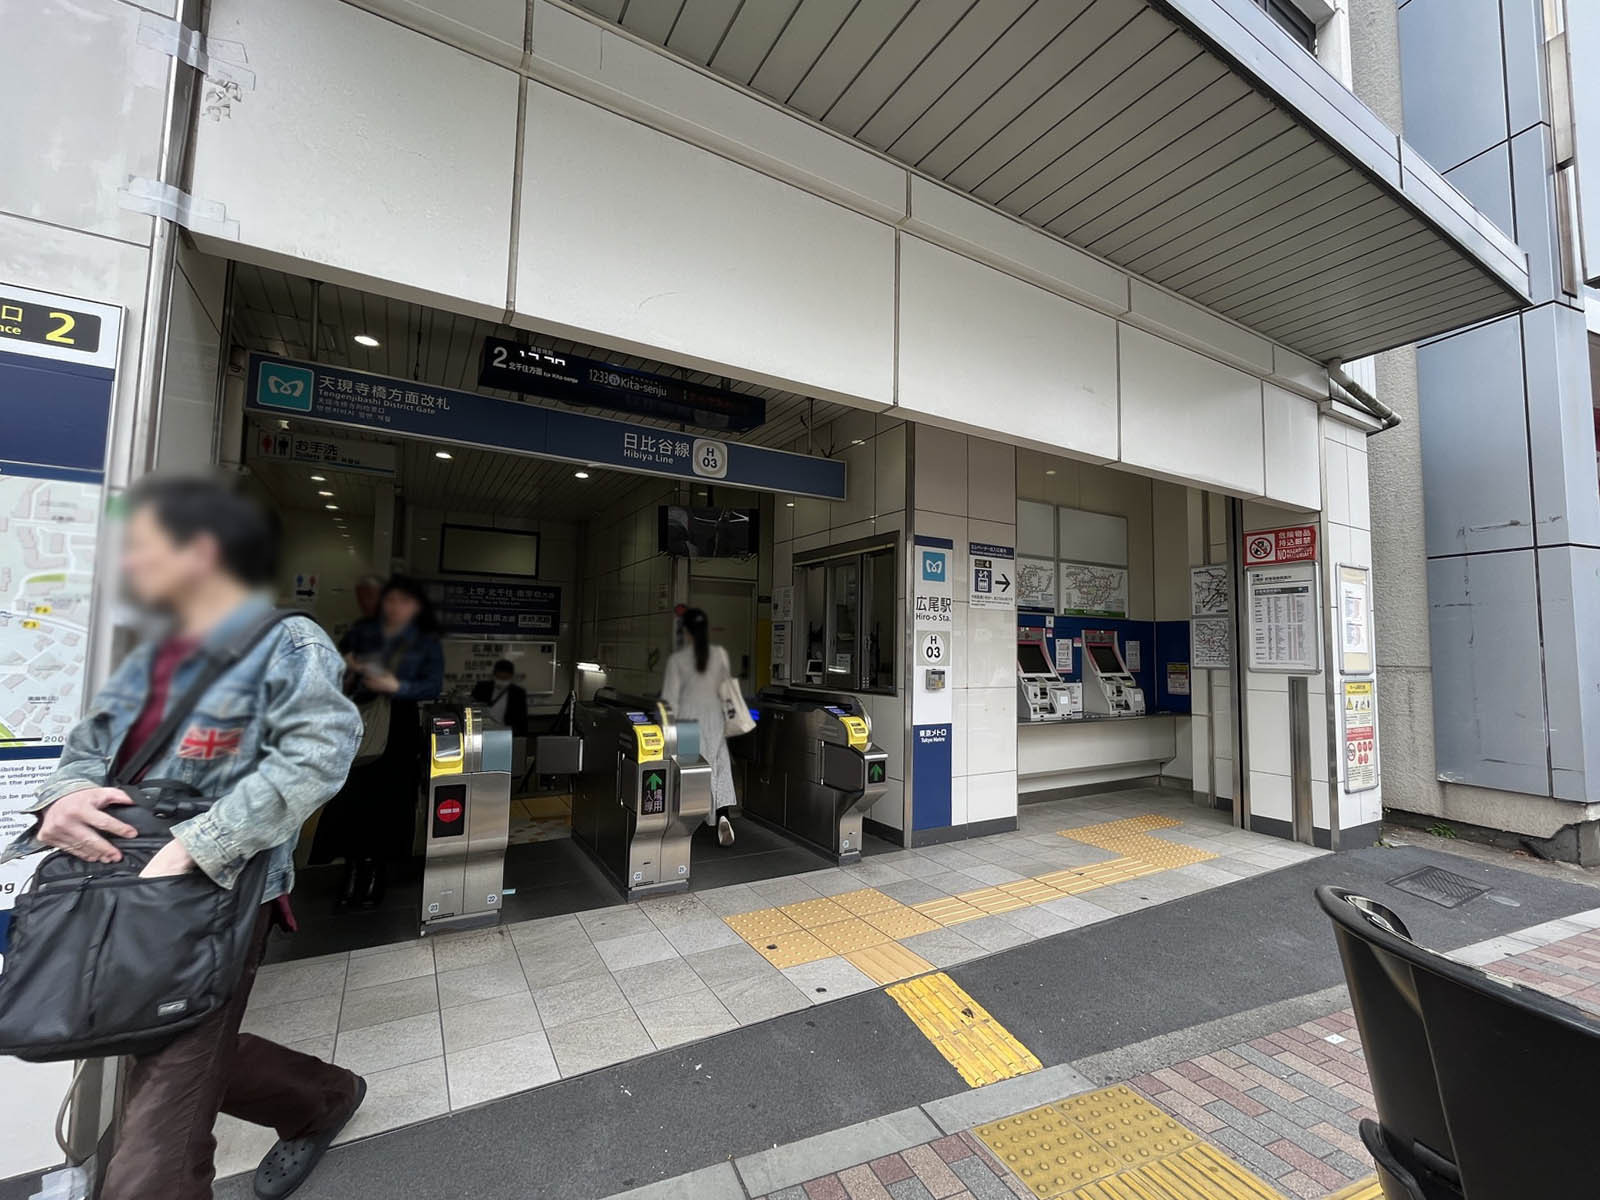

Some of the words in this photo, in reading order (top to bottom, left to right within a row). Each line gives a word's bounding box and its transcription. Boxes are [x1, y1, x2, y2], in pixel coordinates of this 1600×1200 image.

[45, 311, 76, 345] 2
[492, 346, 508, 369] 2
[588, 368, 609, 385] 12:33
[620, 375, 667, 397] Kita-senju
[319, 375, 450, 411] 天現寺橋方面改札
[383, 400, 414, 412] District
[415, 405, 436, 415] Gate
[624, 432, 690, 458] 日比谷線
[706, 447, 715, 457] H
[624, 449, 652, 462] Hibiya
[655, 454, 674, 465] Line
[702, 457, 717, 469] 03
[1277, 549, 1287, 560] NO
[916, 596, 952, 613] 広尾駅
[916, 612, 937, 621] Hiro-o
[938, 613, 952, 622] Sta.
[930, 635, 937, 645] H
[926, 646, 941, 658] 03
